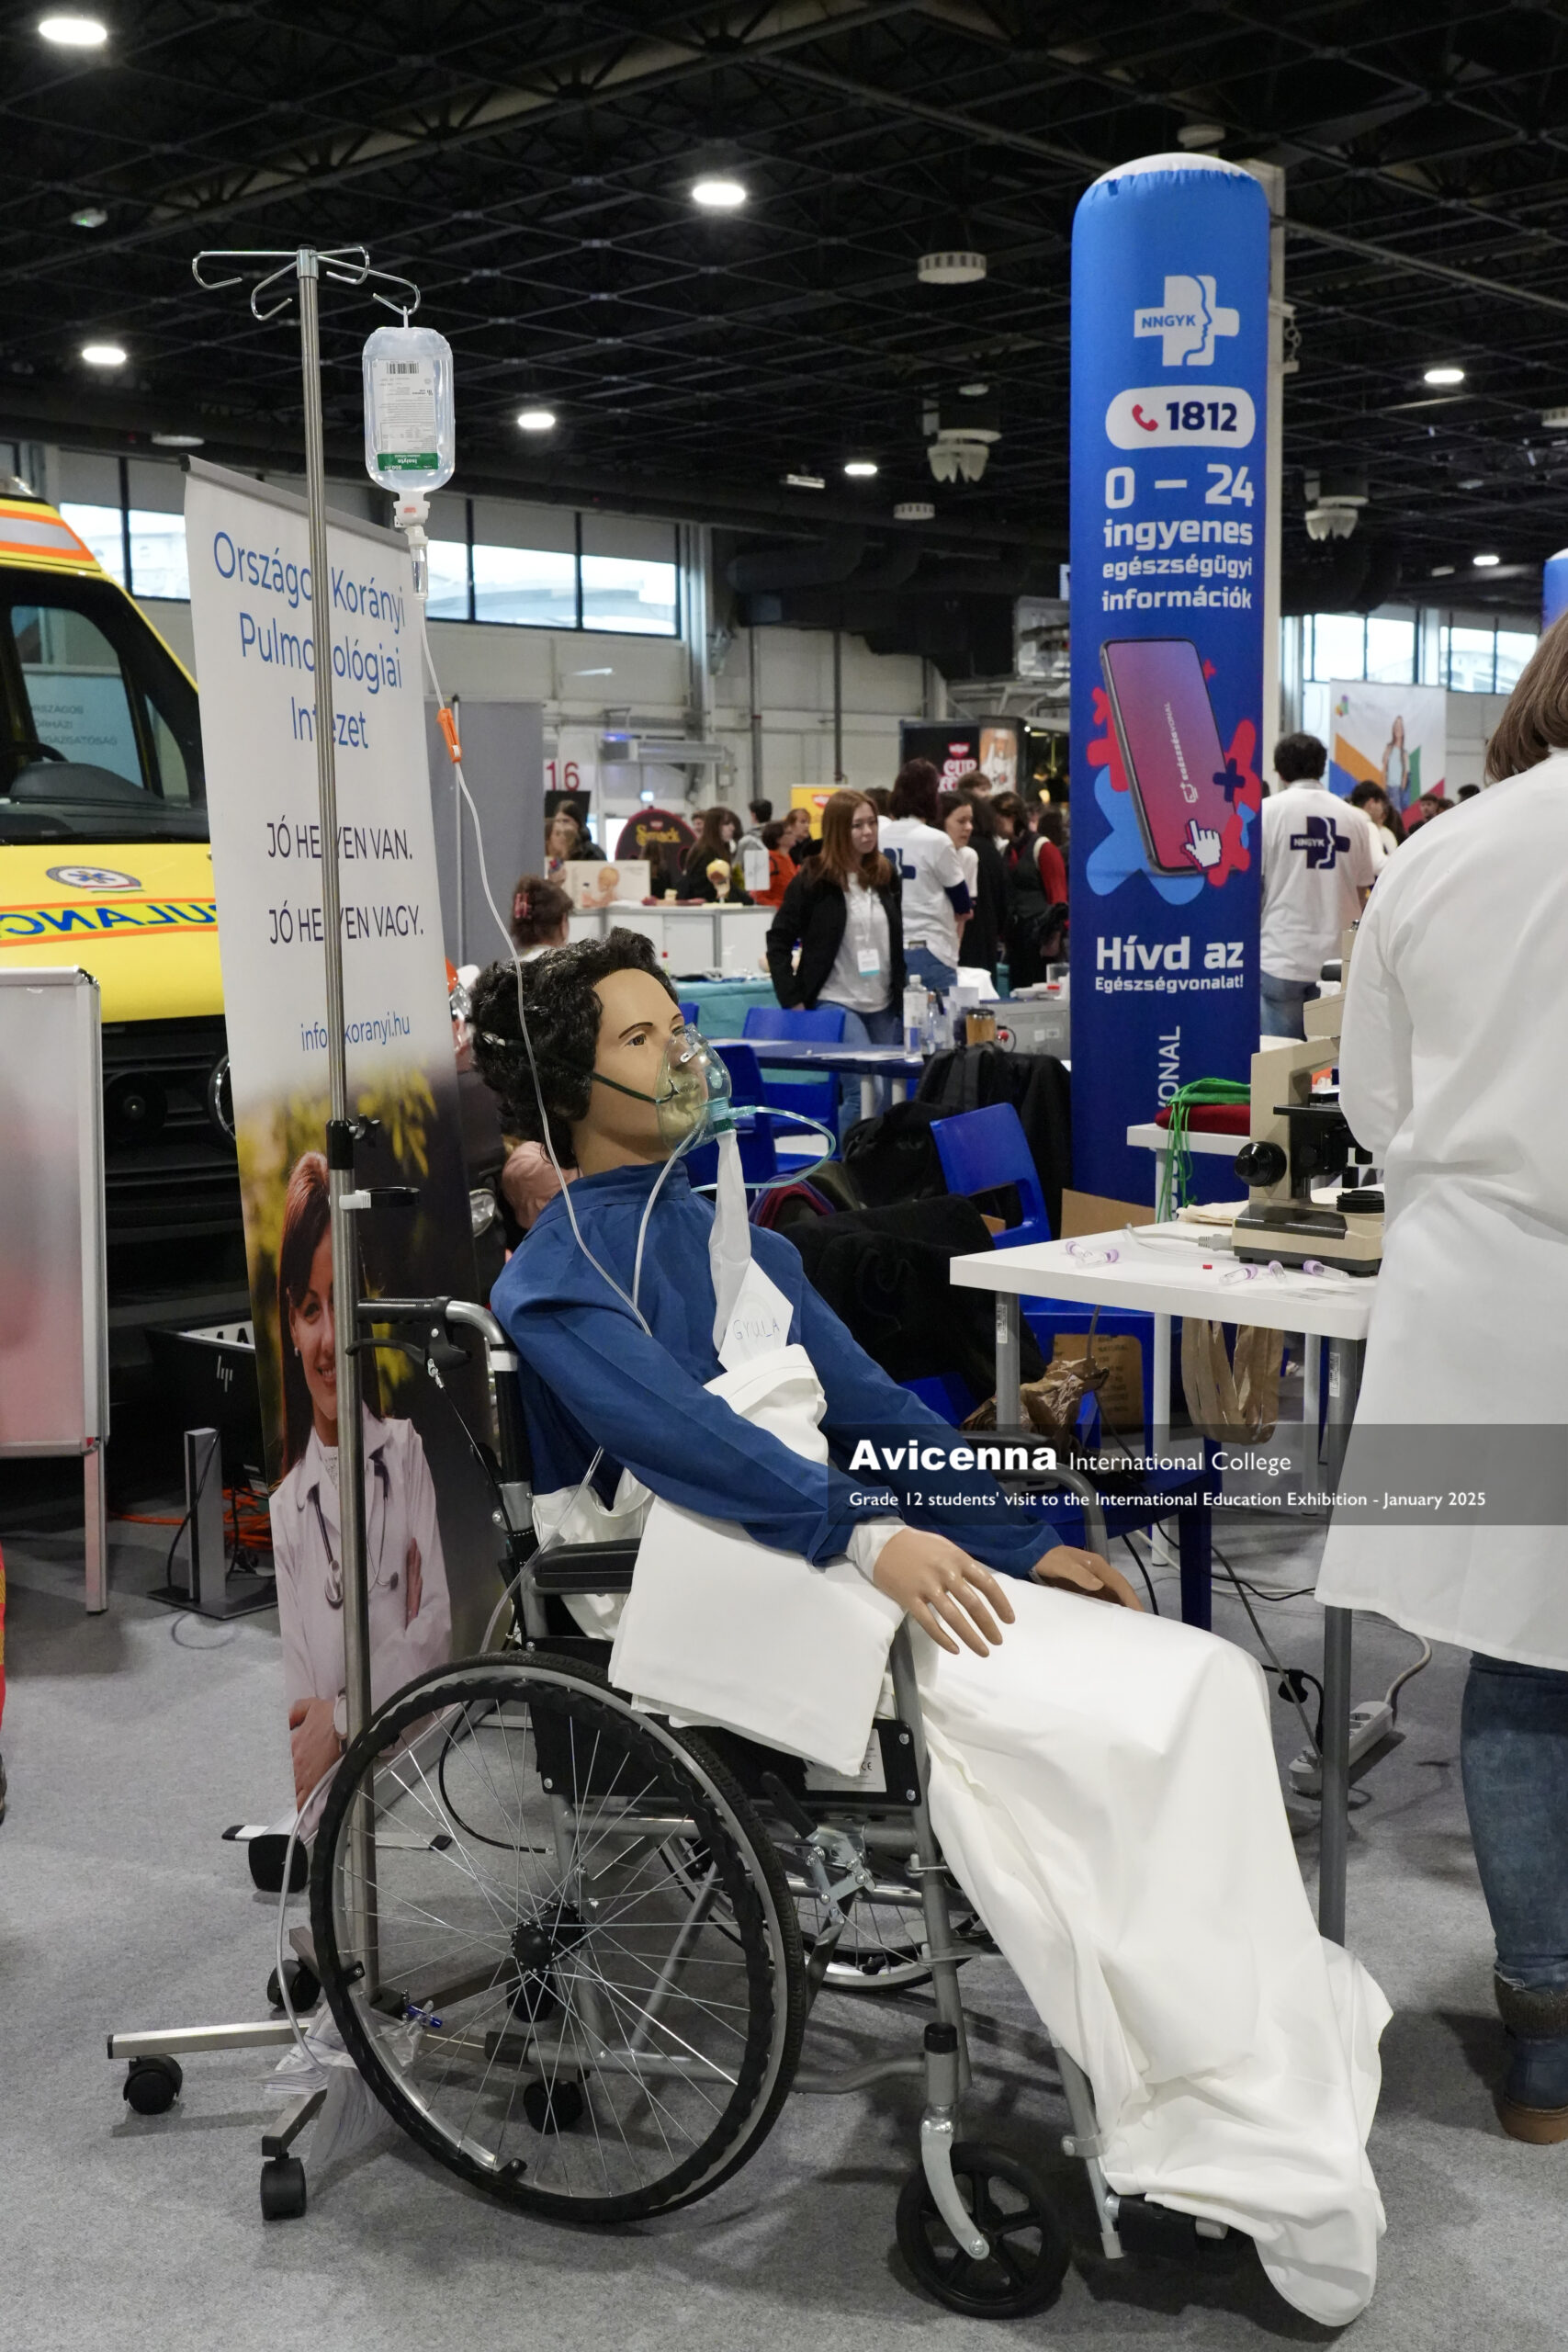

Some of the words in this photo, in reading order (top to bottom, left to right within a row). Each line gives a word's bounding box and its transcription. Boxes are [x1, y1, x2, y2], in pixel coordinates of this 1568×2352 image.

[1142, 314, 1197, 329] NNGYK
[1166, 401, 1237, 433] 1812
[1105, 466, 1135, 510] 0
[1205, 463, 1255, 507] 24
[1103, 518, 1254, 551] ingyenes
[213, 531, 314, 609] Országo
[331, 566, 406, 635] Korányi
[1102, 553, 1253, 582] egészségügyi
[1102, 585, 1253, 612] információk
[239, 612, 402, 695] Pulmoológiai
[546, 761, 581, 791] 16
[266, 814, 292, 858] JÓ
[369, 827, 413, 860] VAN.
[268, 899, 294, 944] JÓ
[372, 905, 424, 937] VAGY.
[1096, 934, 1190, 971] Hívd
[1203, 941, 1245, 969] az
[1095, 974, 1245, 994] Egészségvonalat!
[300, 1012, 411, 1052] infokoranyi.hu
[732, 1317, 781, 1340] GYULA
